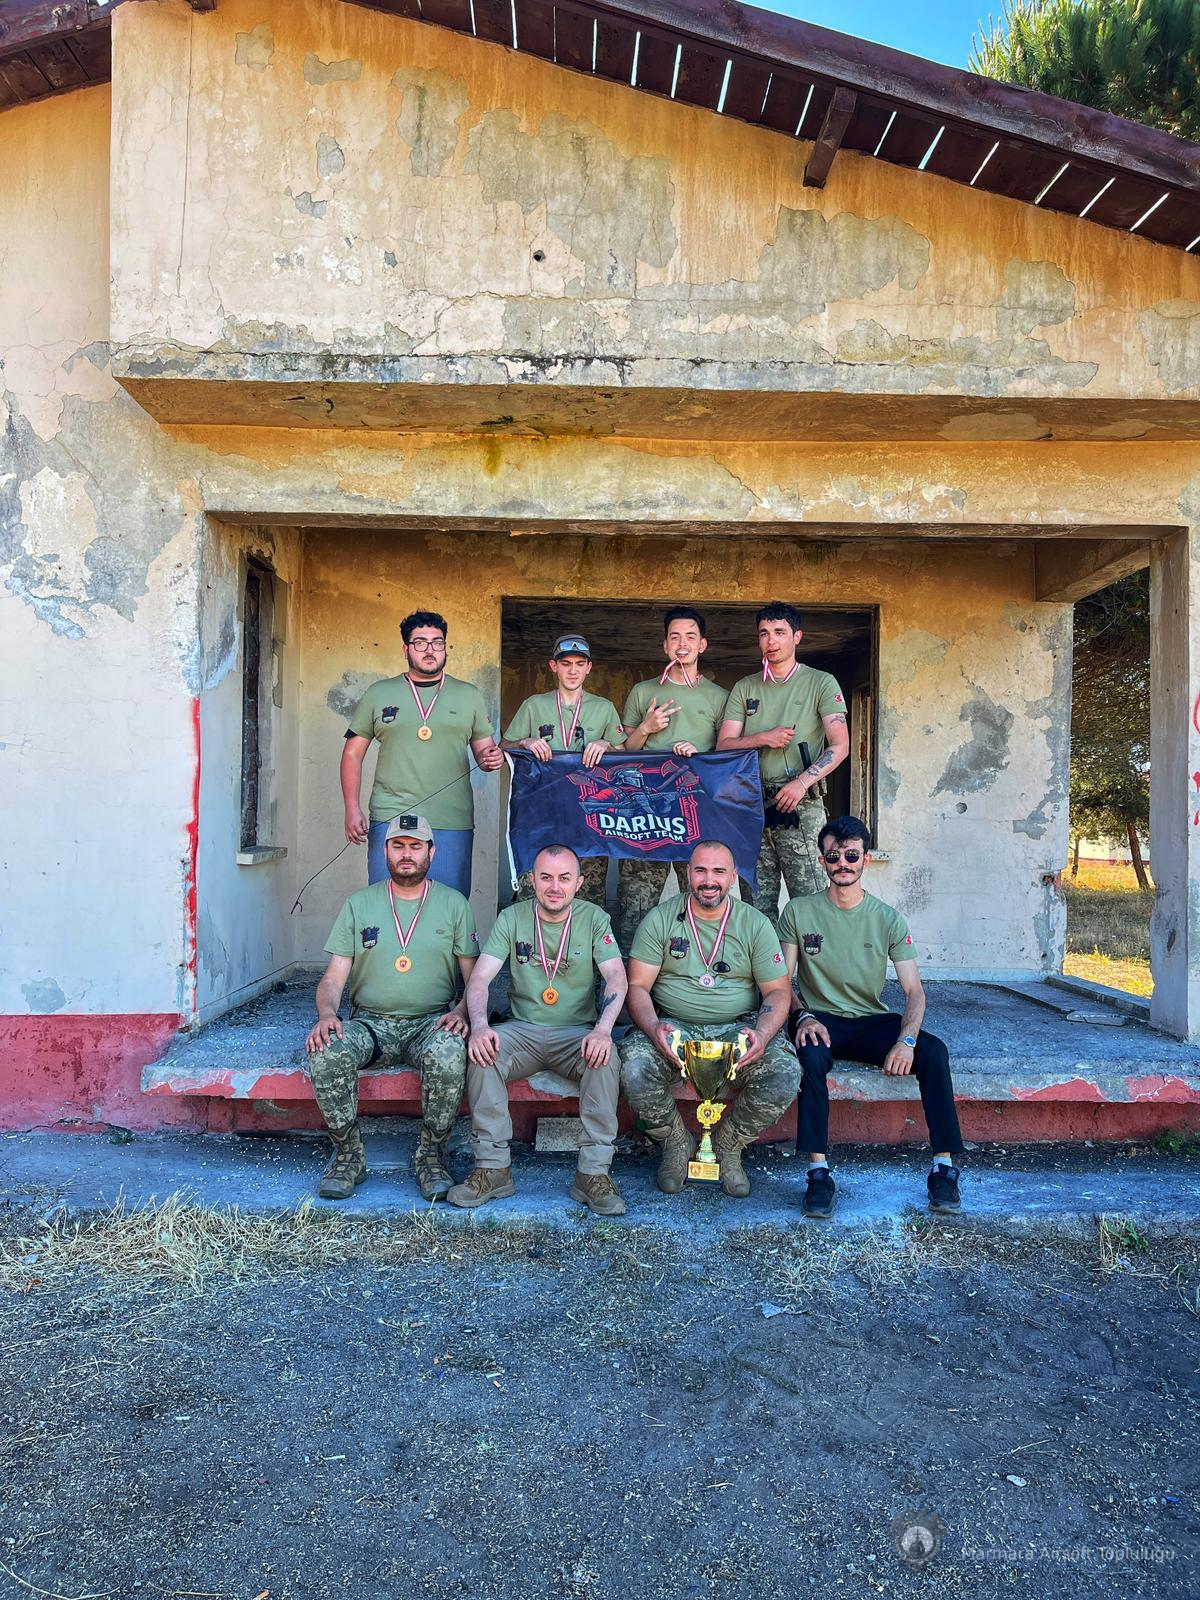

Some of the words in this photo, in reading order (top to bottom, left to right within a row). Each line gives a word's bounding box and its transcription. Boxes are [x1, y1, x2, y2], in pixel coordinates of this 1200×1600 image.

[599, 813, 686, 835] DARIUS
[605, 829, 651, 841] AIRSOFT
[654, 830, 684, 843] TEAM
